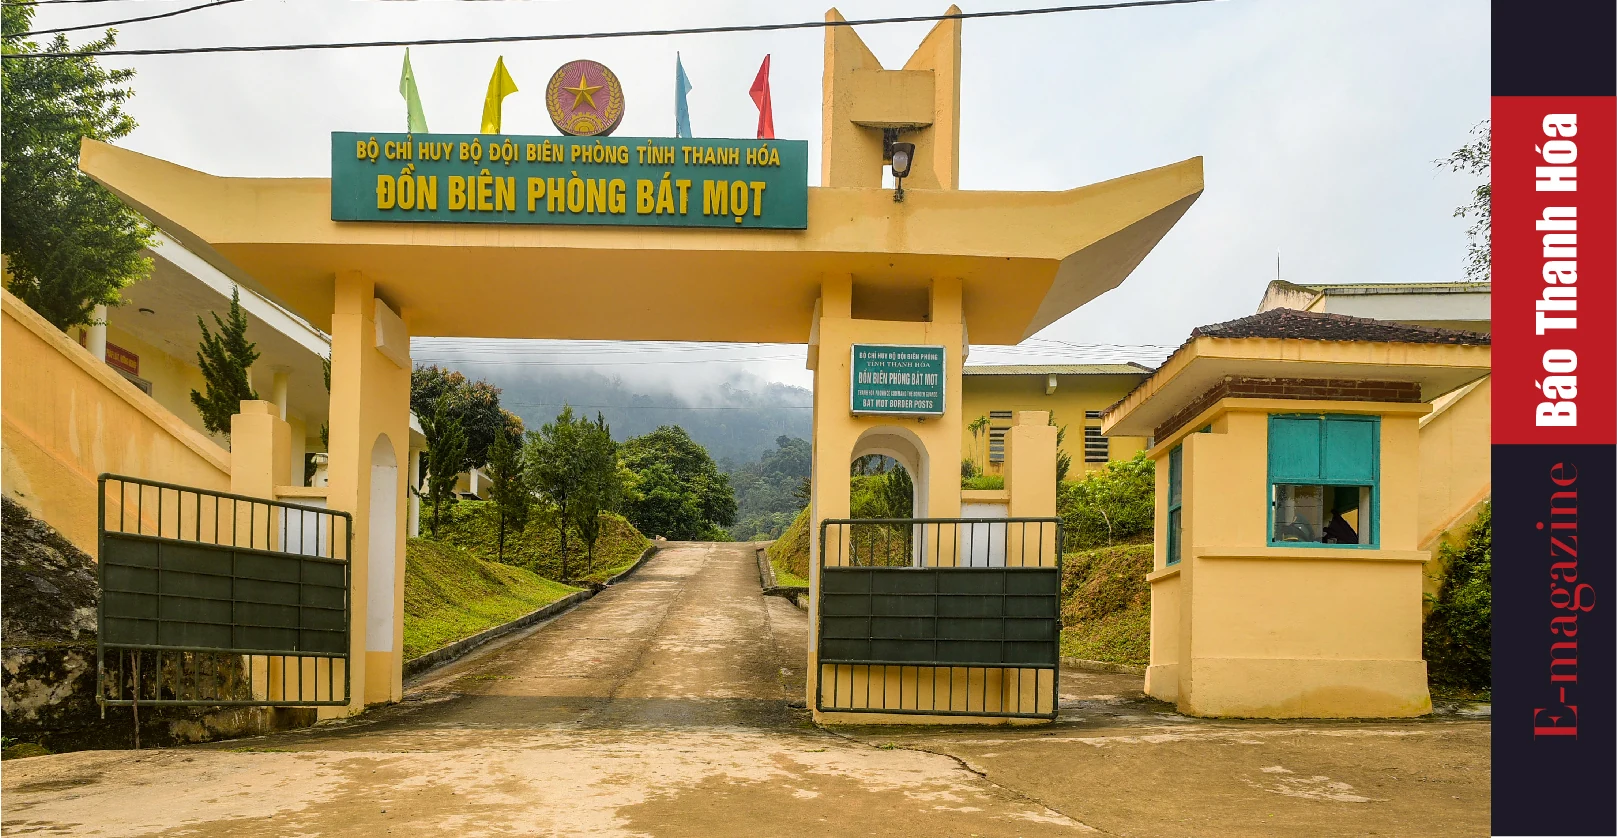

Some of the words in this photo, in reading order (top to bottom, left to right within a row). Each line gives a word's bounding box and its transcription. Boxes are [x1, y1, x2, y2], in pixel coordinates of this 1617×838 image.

[356, 137, 380, 163] BỘ
[384, 135, 413, 160] CHỈ
[418, 142, 454, 161] HUY
[459, 138, 482, 164] BỘ
[488, 139, 519, 164] ĐỘI
[526, 139, 563, 163] BIÊN
[570, 140, 629, 165] PHÒNG
[637, 140, 675, 164] TỈNH
[682, 146, 740, 165] THANH
[745, 143, 781, 167] HÓA
[376, 163, 437, 211] ĐỒN
[448, 169, 515, 213] BIÊN
[527, 171, 626, 215] PHÒNG
[636, 171, 691, 216] BÁT
[703, 179, 766, 223] MỌT
[889, 399, 913, 408] BORDER
[914, 400, 933, 409] POSTS
